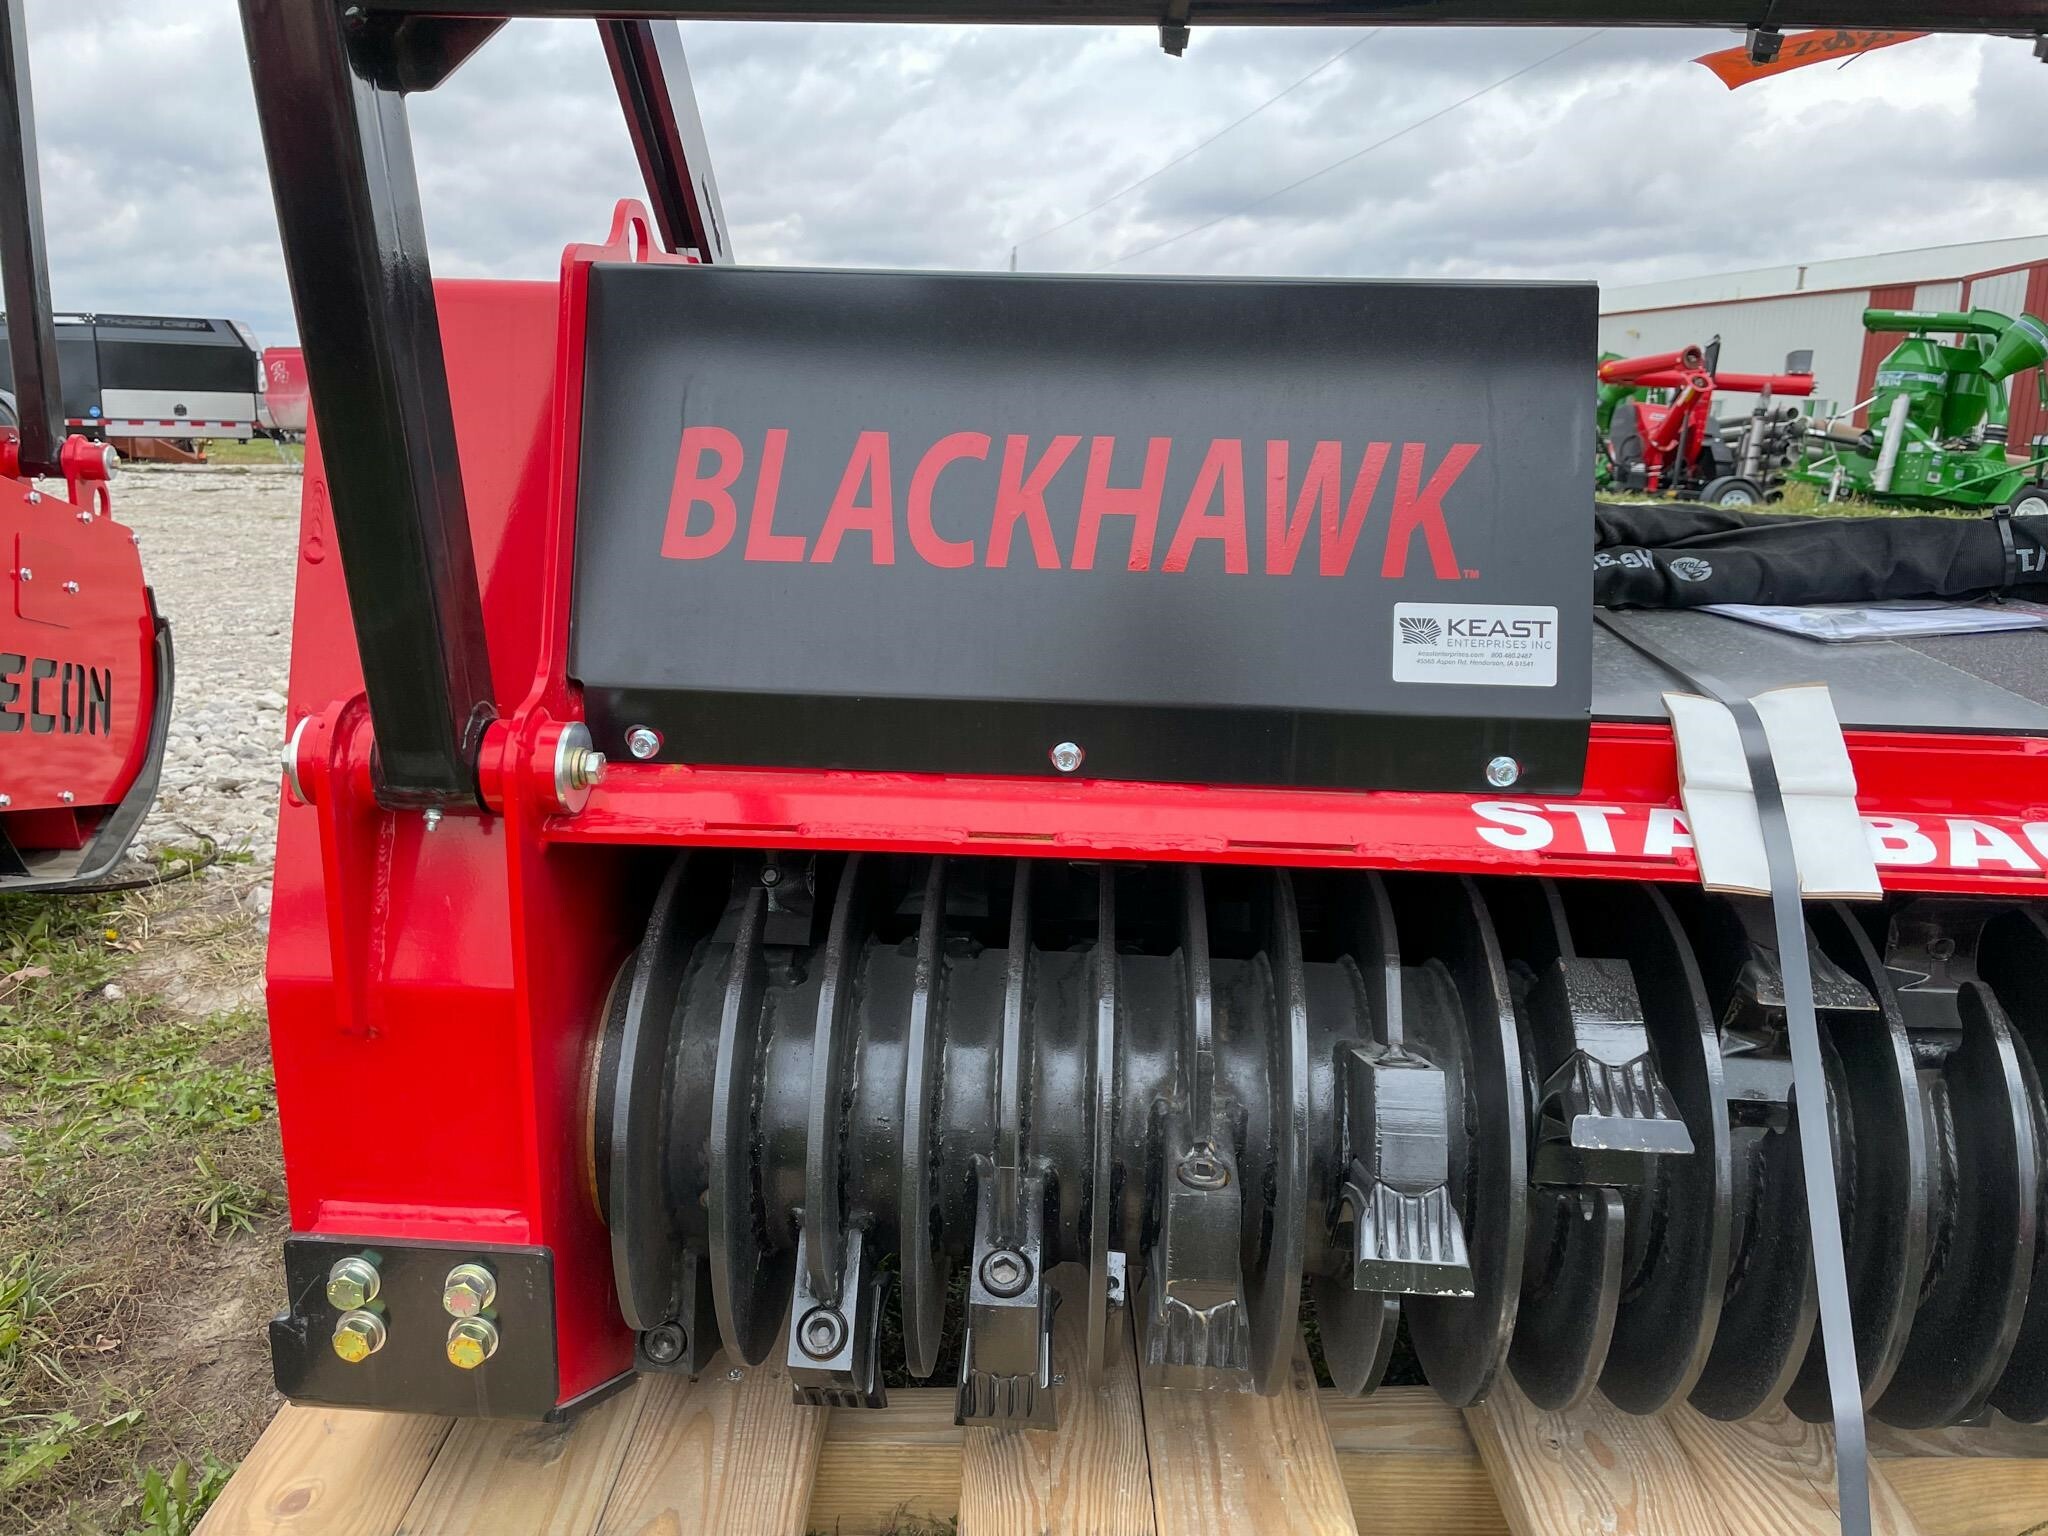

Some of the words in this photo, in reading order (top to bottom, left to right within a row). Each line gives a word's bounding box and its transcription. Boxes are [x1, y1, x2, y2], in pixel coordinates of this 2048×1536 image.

[660, 426, 1482, 580] BLACKHAWK
[1447, 618, 1552, 639] KEAST
[1447, 638, 1527, 650] ENTERPRISES
[1531, 641, 1552, 650] INC
[1475, 801, 1694, 856] STA
